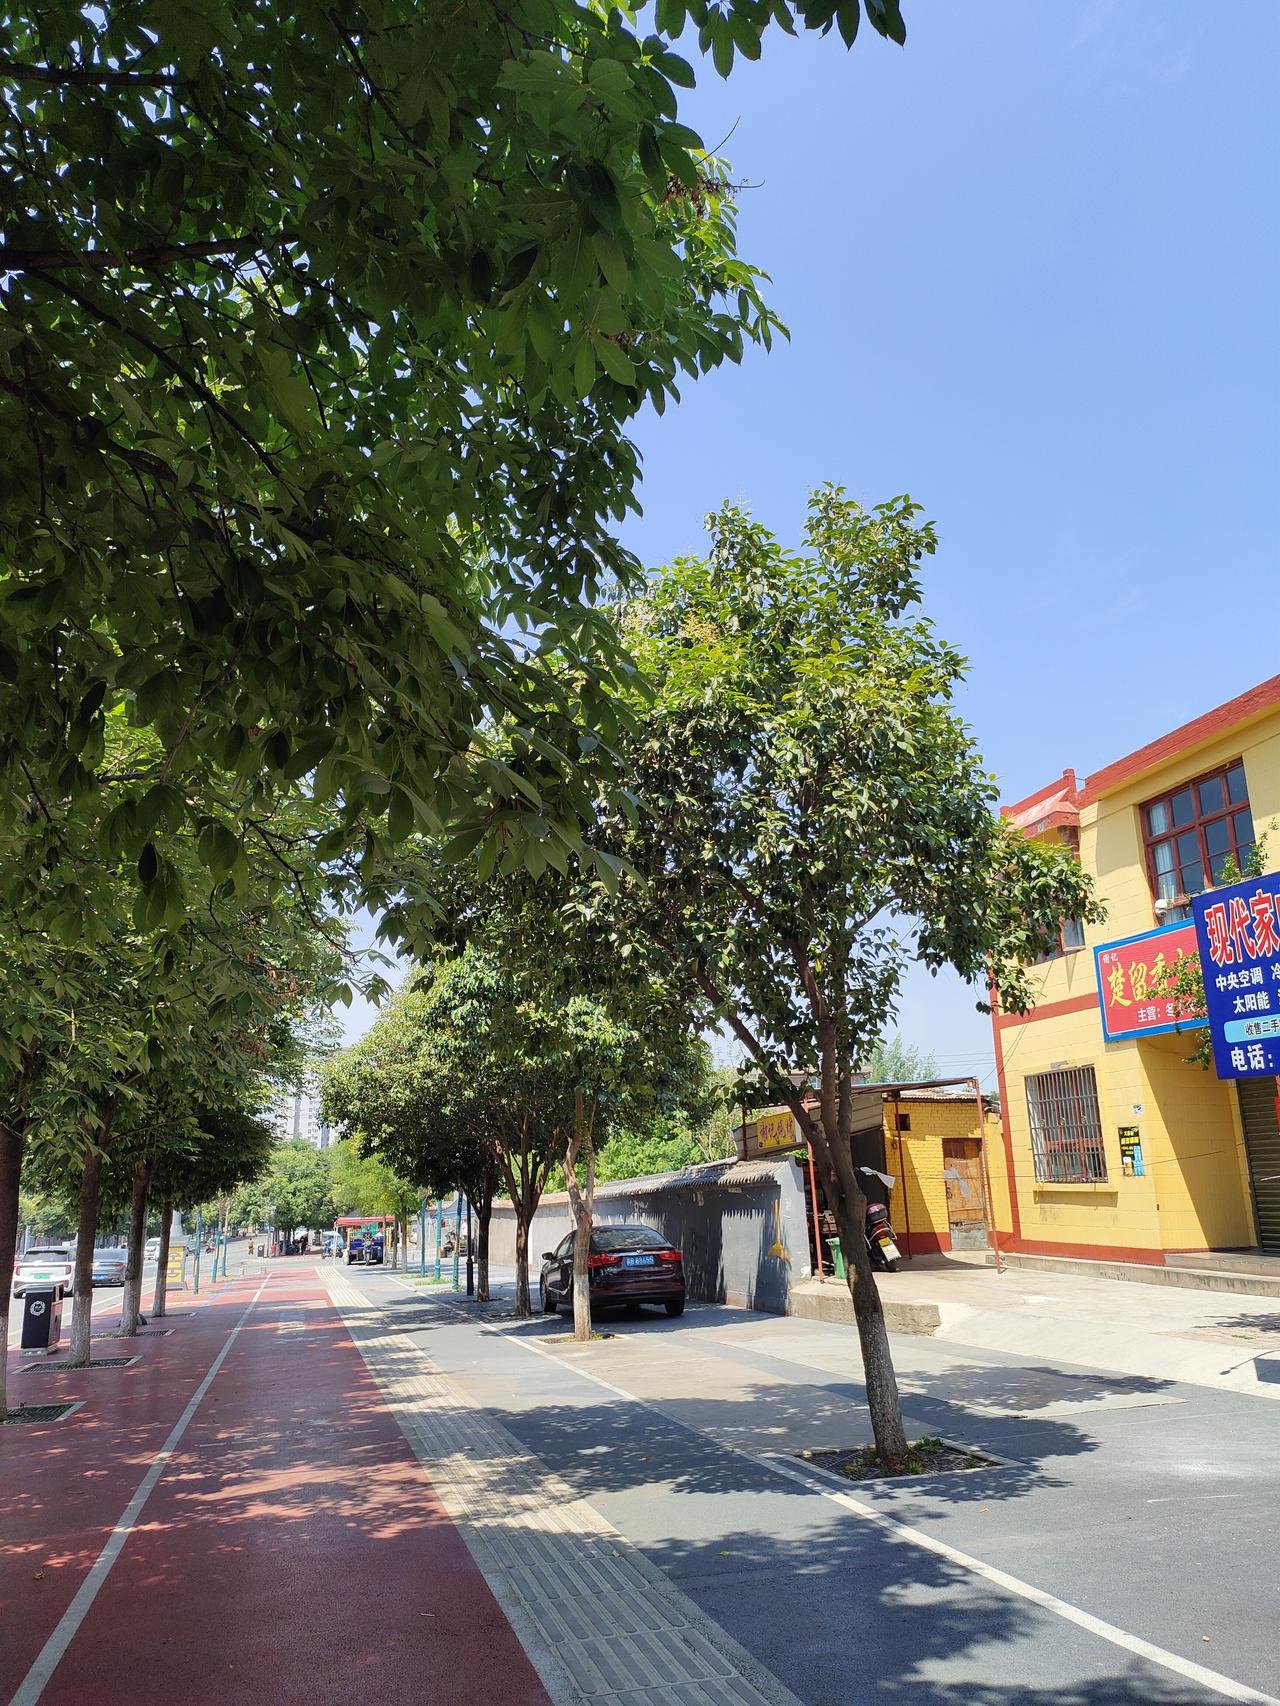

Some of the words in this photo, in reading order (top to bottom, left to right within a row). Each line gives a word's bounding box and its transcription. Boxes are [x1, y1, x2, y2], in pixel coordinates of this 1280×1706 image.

[1203, 889, 1280, 967] 现代家
[1107, 947, 1184, 1007] 楚留香
[1215, 966, 1263, 992] 中央空调
[1233, 991, 1270, 1014] 太阳能
